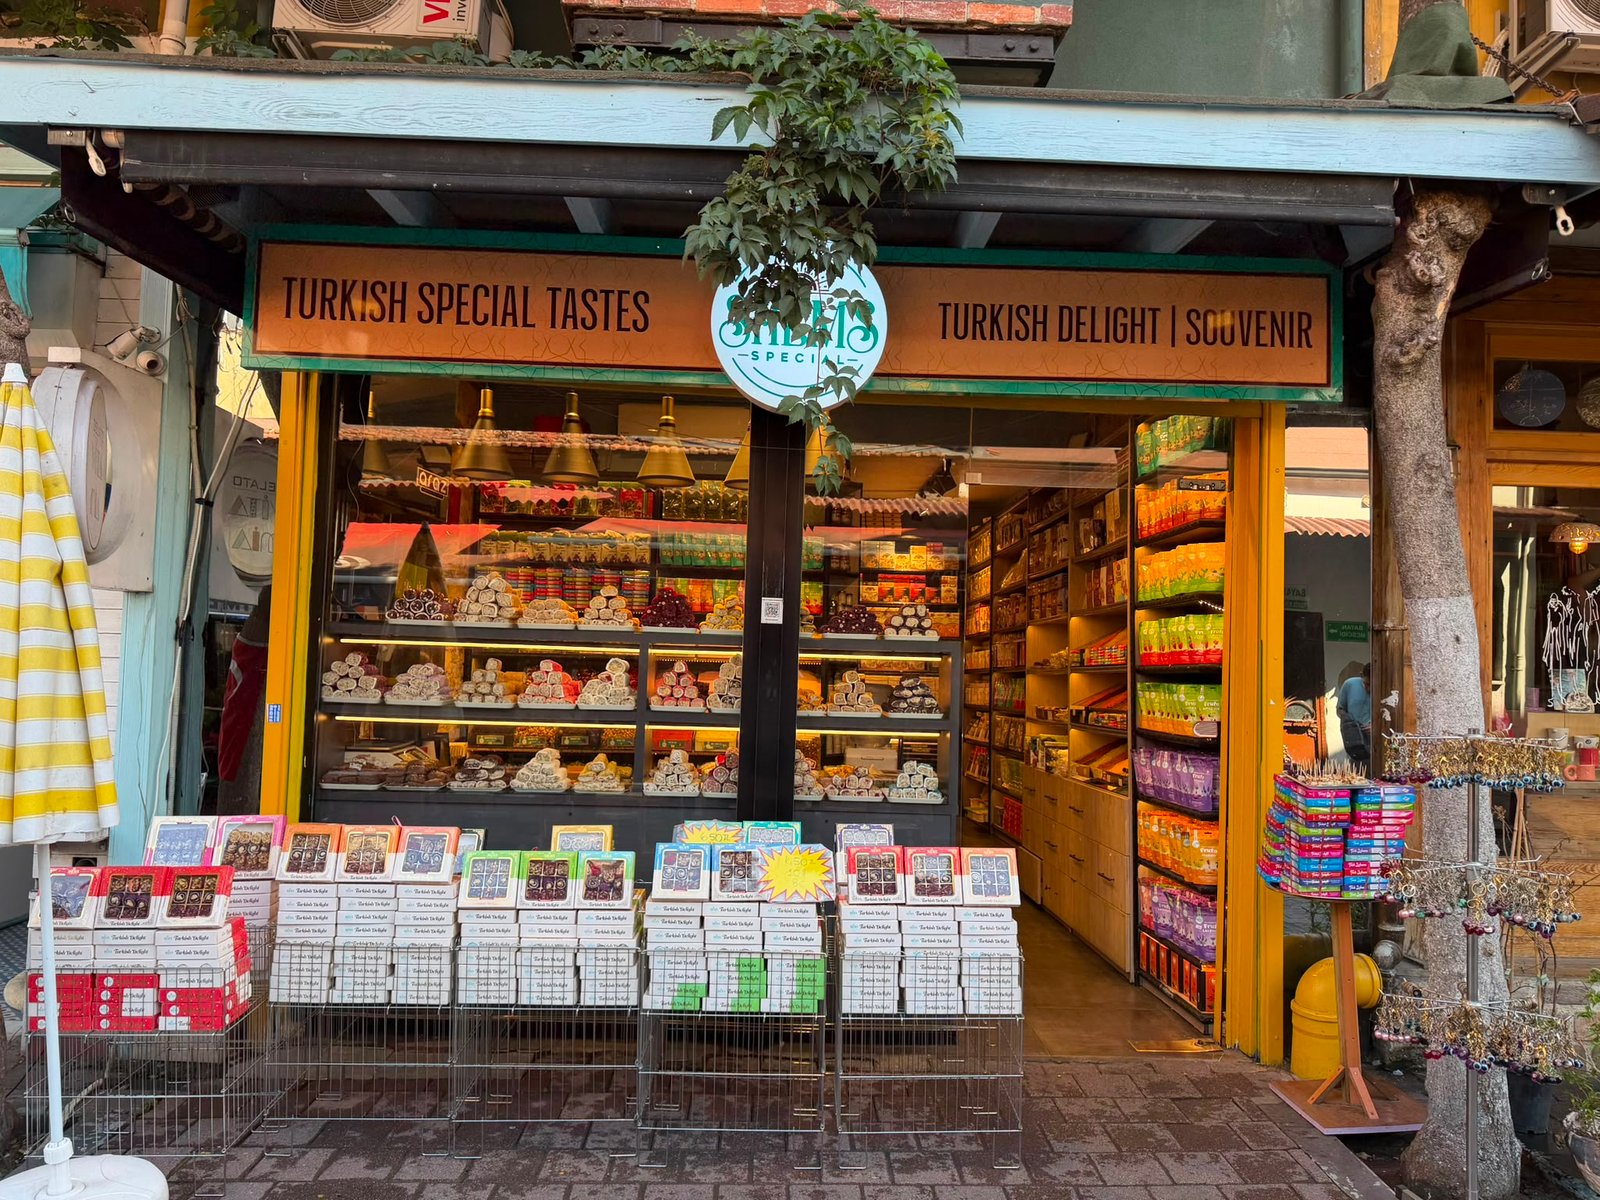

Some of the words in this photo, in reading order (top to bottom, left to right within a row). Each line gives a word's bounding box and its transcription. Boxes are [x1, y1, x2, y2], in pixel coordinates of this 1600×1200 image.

[452, 0, 467, 21] inv
[282, 276, 408, 323] TURKISH
[416, 281, 536, 328] SPECIAL
[546, 286, 650, 333] TASTES
[938, 301, 1048, 342] TURKISH
[1057, 304, 1161, 345] DELIGHT
[1185, 307, 1313, 349] SOUVENIR
[751, 350, 845, 365] SPECIAL
